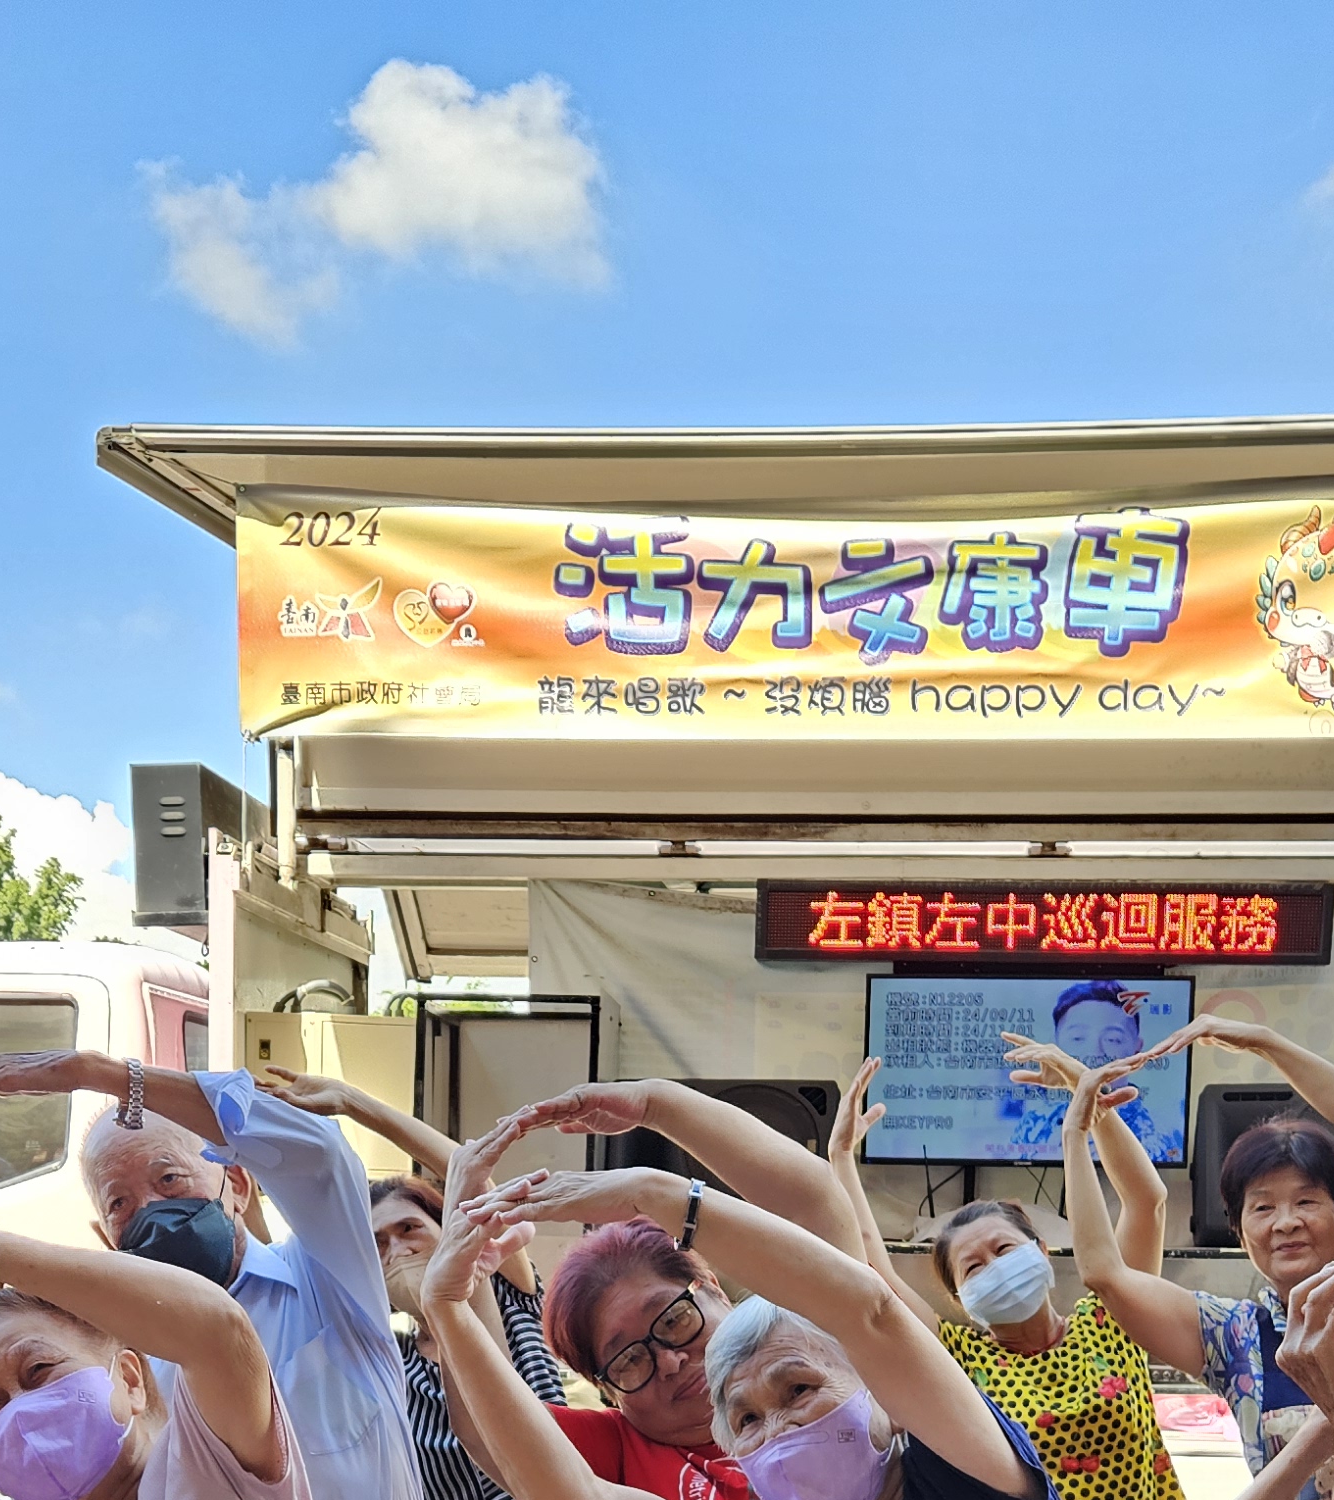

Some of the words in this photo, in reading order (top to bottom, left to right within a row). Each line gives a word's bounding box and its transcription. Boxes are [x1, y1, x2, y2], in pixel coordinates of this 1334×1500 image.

[279, 506, 381, 548] 2024
[554, 508, 1190, 666] 活力文康車
[909, 678, 1082, 719] happy
[810, 890, 1279, 953] 左鎮左中巡迴服務
